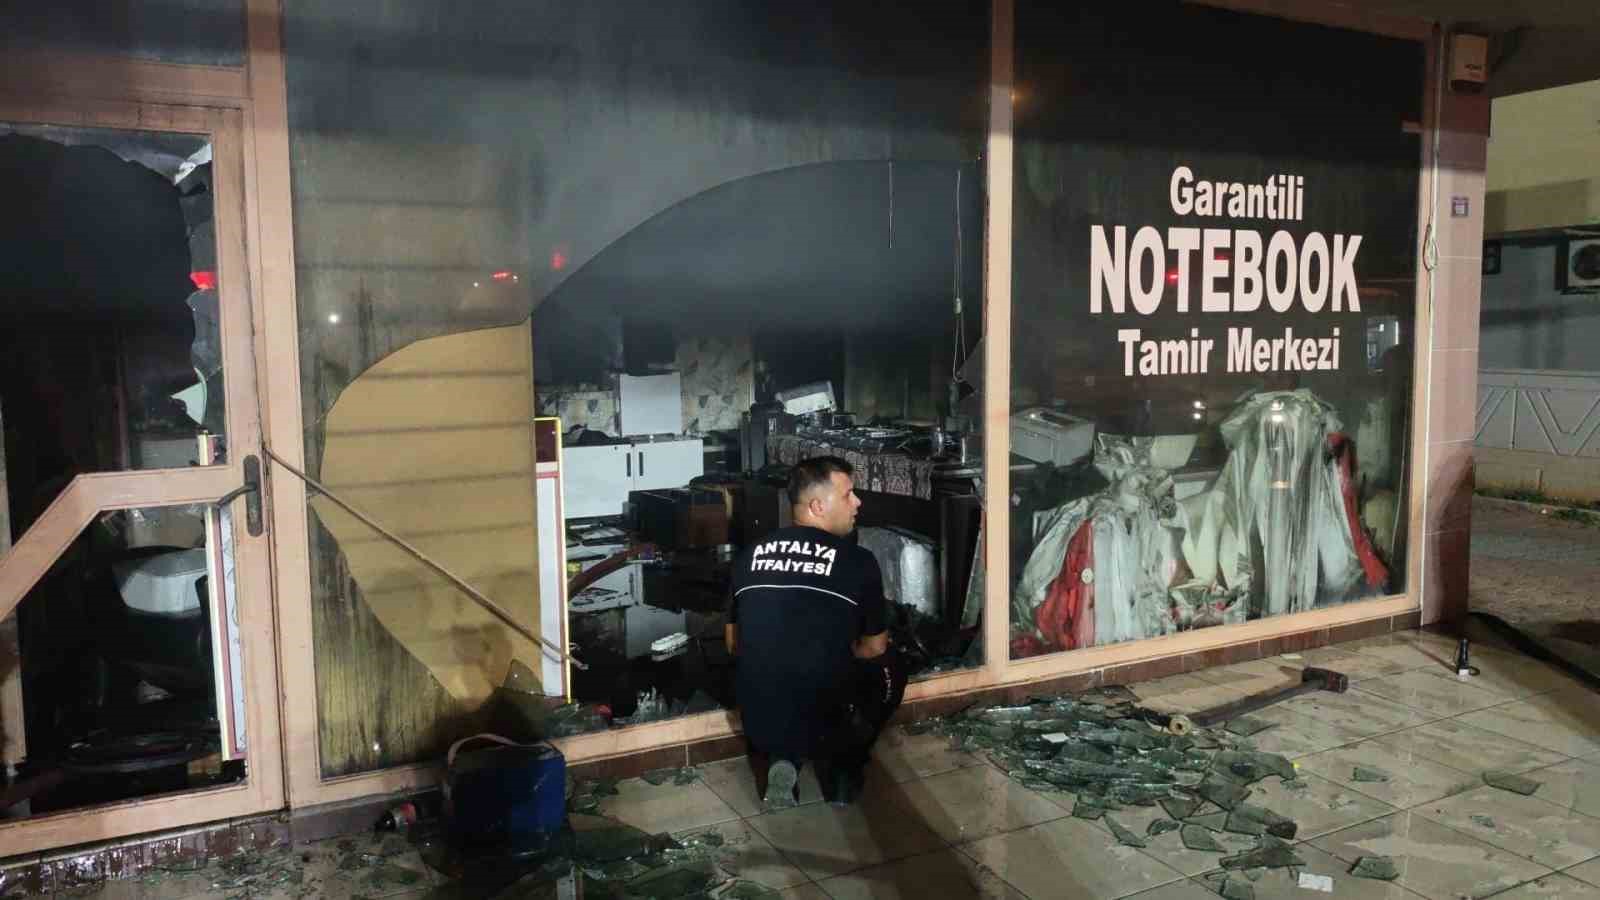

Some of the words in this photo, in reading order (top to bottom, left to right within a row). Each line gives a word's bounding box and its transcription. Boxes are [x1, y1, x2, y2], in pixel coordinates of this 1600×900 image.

[1170, 166, 1304, 221] Garantili
[1089, 224, 1363, 315] NOTEBOOK
[1117, 328, 1213, 377] Tamir
[1227, 327, 1339, 373] Merkezi
[751, 557, 833, 576] İTFAİYESİ
[753, 540, 837, 562] ANTALYA
